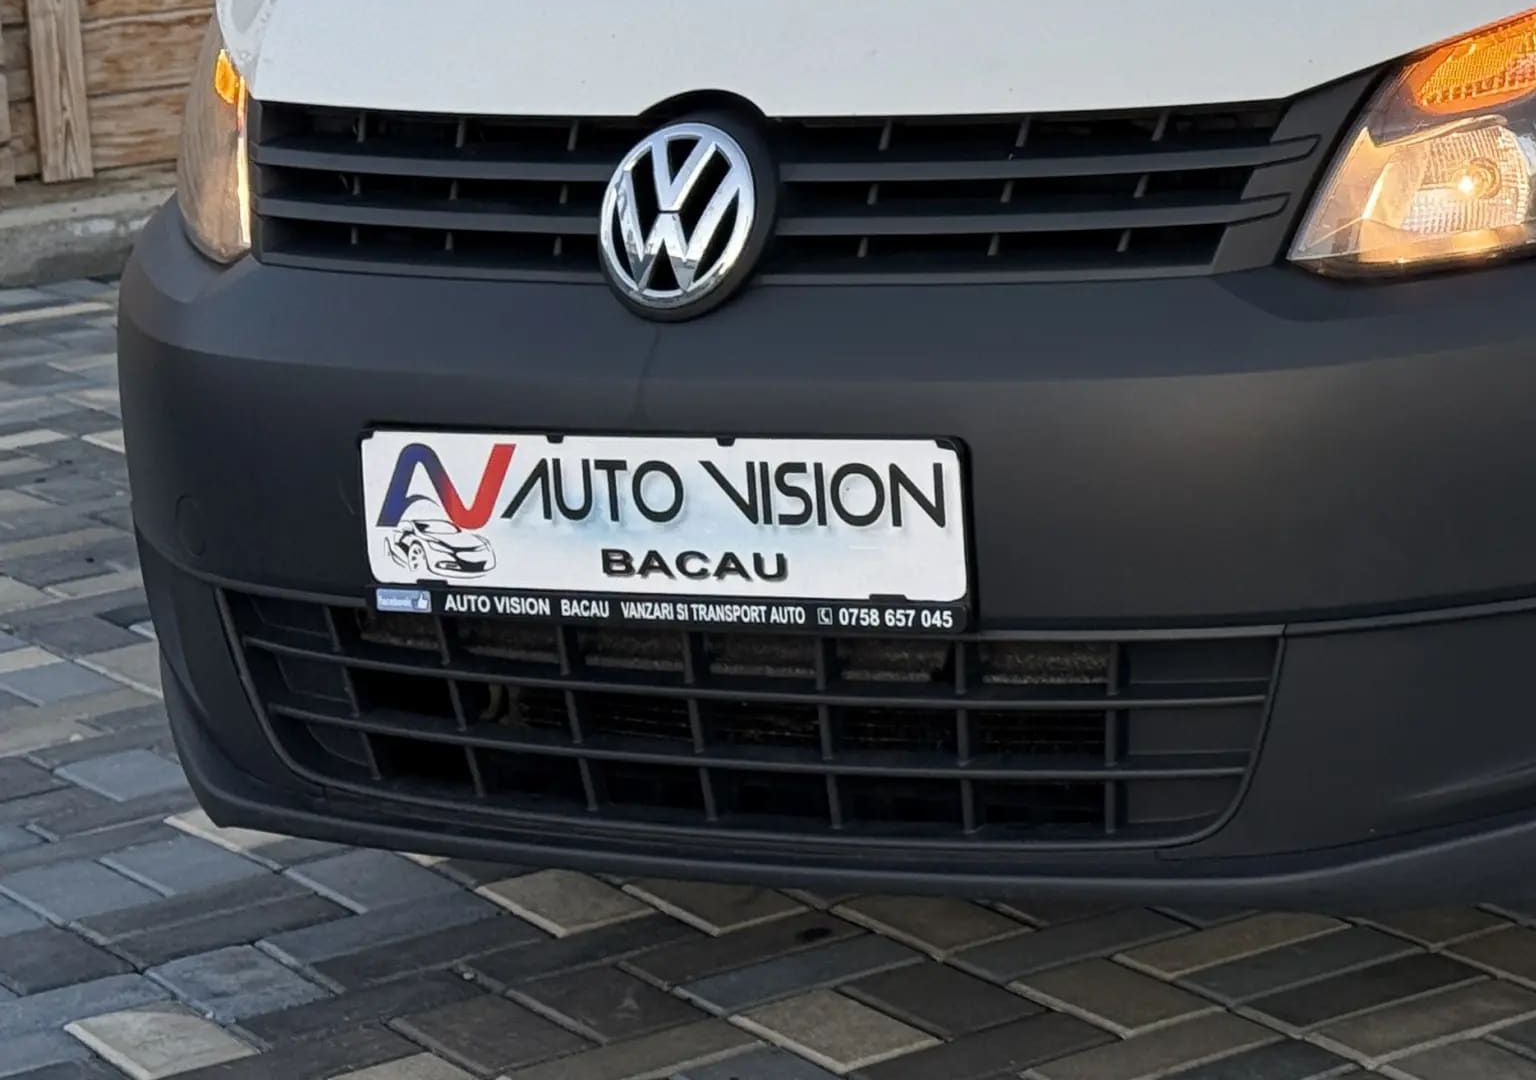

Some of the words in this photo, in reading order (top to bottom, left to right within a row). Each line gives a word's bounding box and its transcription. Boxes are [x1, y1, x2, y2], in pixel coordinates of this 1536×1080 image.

[500, 457, 685, 524] AUTO
[698, 460, 947, 528] VISION
[601, 548, 789, 581] BACAU
[444, 594, 491, 613] AUTO
[493, 596, 551, 616] VISION
[560, 599, 610, 618] BACAU
[620, 601, 674, 620] VANZARI
[676, 603, 689, 621] SI
[690, 603, 767, 624] TRANSPORT
[770, 606, 806, 624] AUTO
[838, 607, 880, 626] 0758
[884, 609, 916, 627] 657
[920, 609, 953, 628] 045
